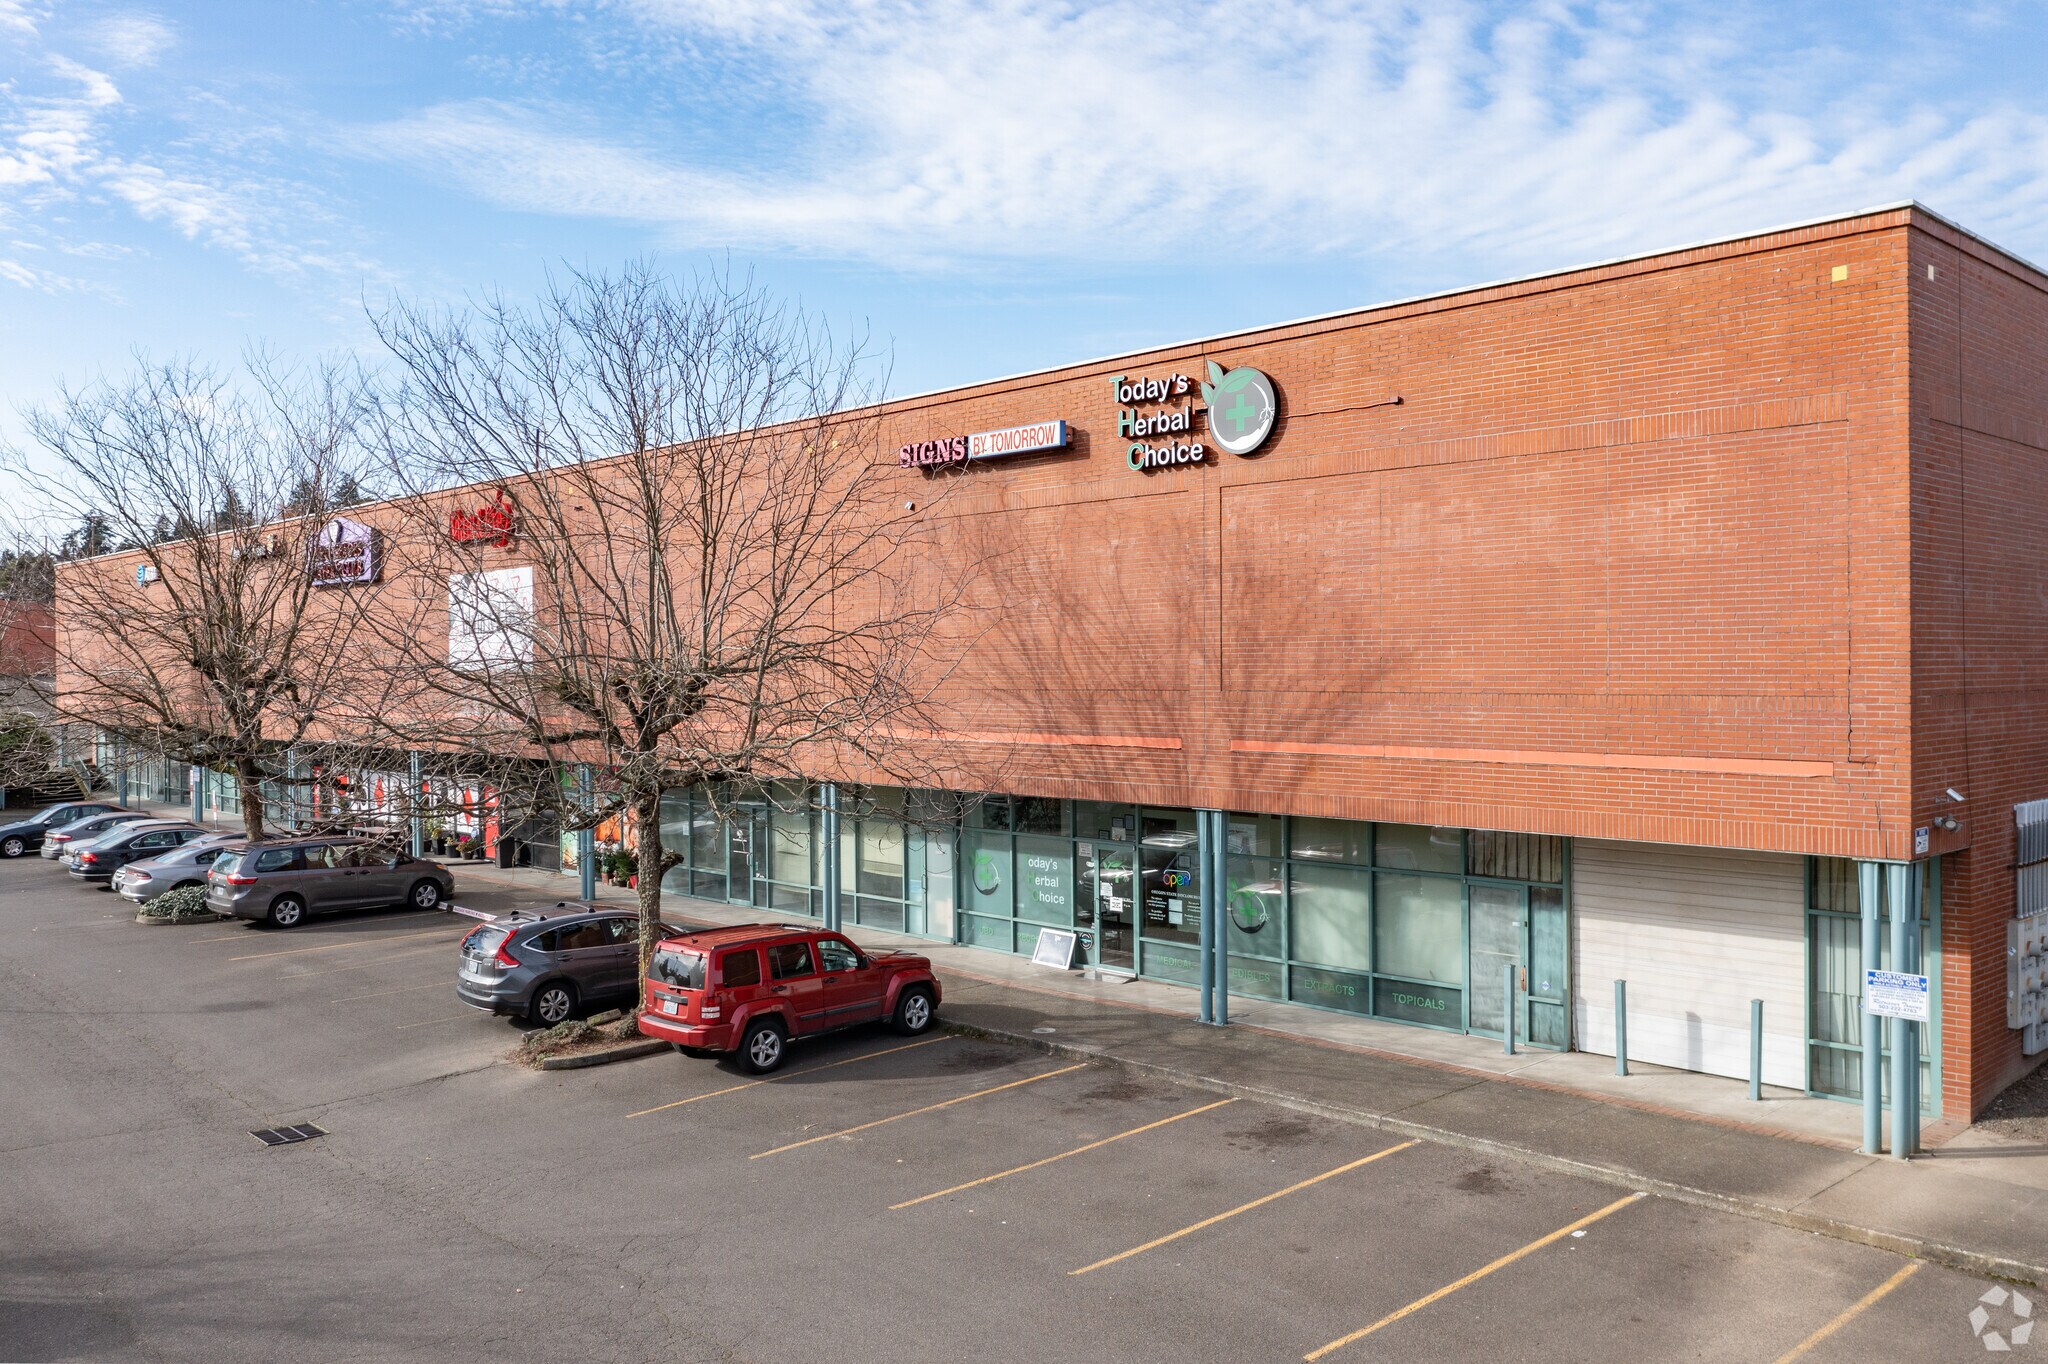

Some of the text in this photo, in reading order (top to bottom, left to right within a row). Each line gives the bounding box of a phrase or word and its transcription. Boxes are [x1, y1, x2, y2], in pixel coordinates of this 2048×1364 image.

[1109, 373, 1188, 403] Today's
[1117, 406, 1190, 437] Herbal
[899, 423, 1056, 469] SIGNS BY TOMORROW
[1127, 441, 1203, 471] Choice
[1156, 955, 1194, 969] MEDICAL
[1232, 968, 1271, 982] EDIBLES
[1868, 976, 1904, 986] PARKING
[1905, 980, 1927, 988] ONLY
[1874, 972, 1920, 982] CUSTOMER
[1304, 979, 1355, 997] EXTRACTS
[1391, 993, 1446, 1011] TOPICALS
